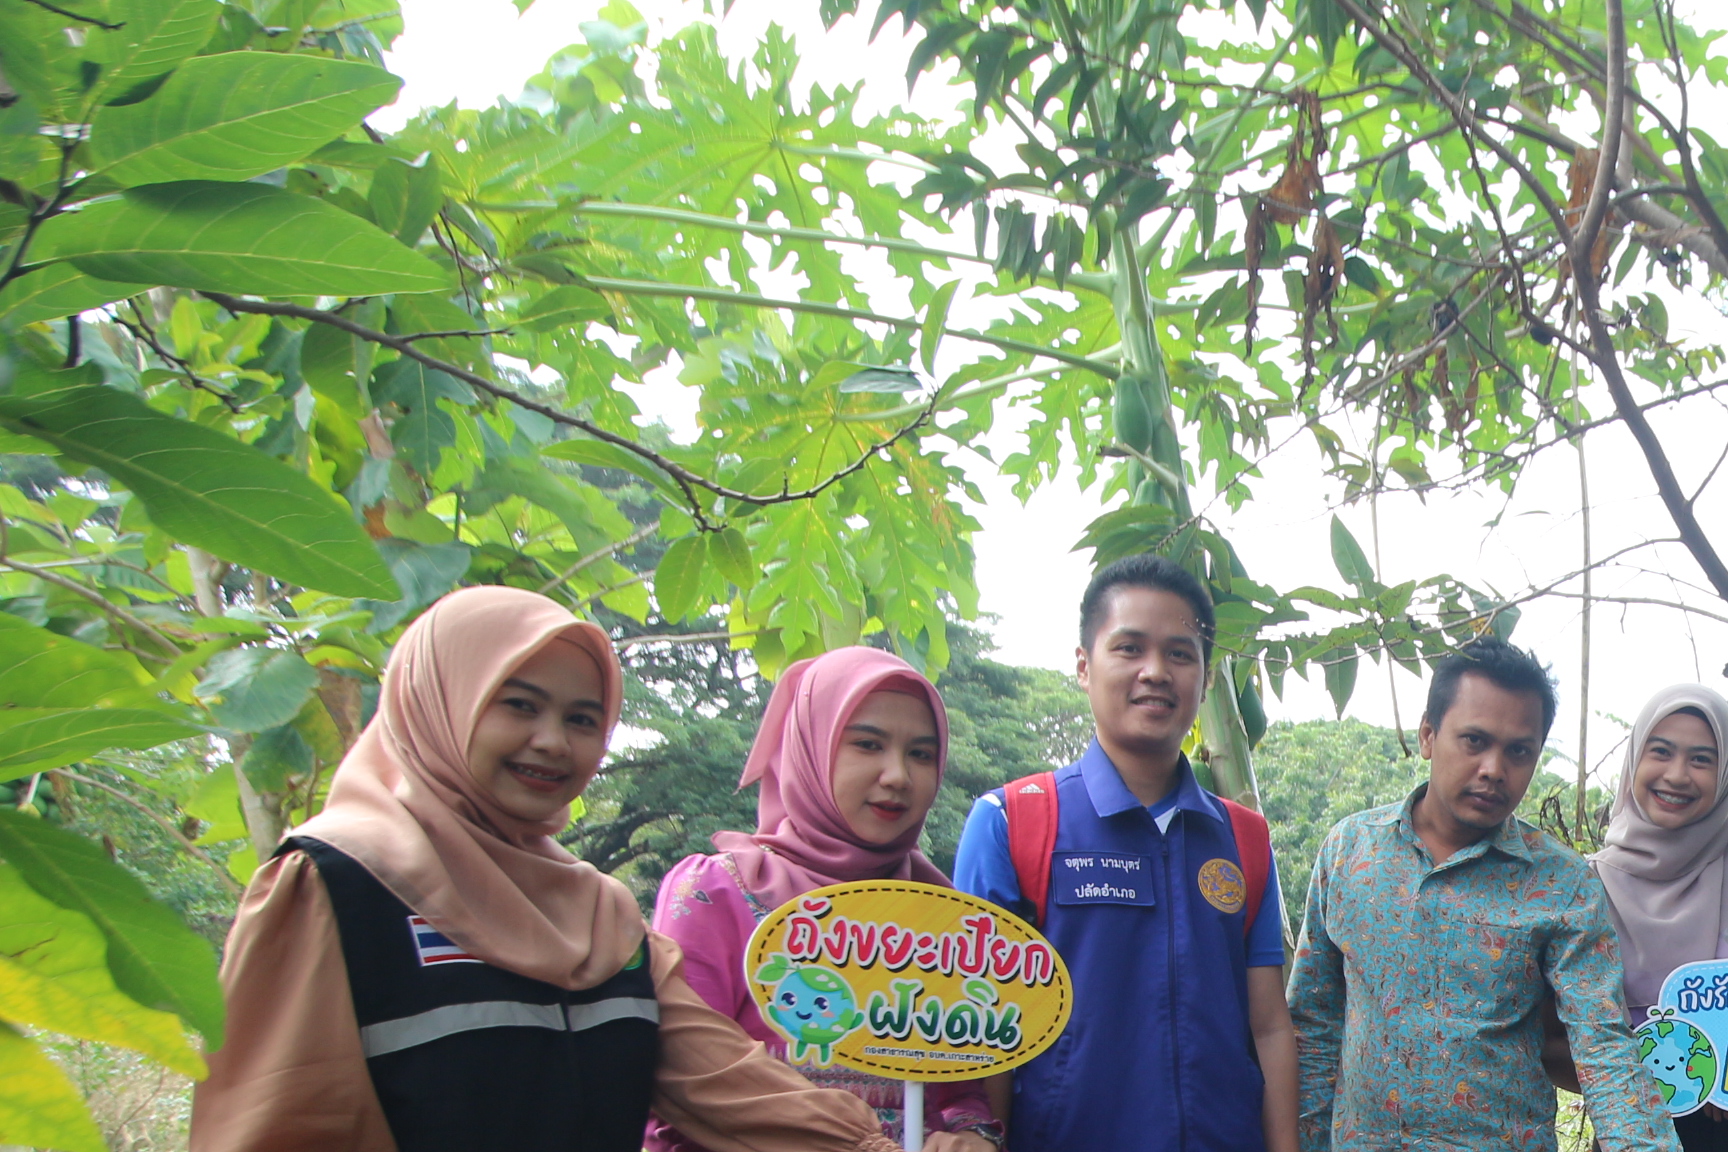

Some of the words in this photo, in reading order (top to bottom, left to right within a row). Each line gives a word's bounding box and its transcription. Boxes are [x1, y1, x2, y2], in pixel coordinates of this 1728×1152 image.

[1075, 883, 1136, 899] ปลัดอำเภอ
[787, 898, 1051, 981] ถังขยะเปียก
[868, 979, 1019, 1047] ฝังดิน
